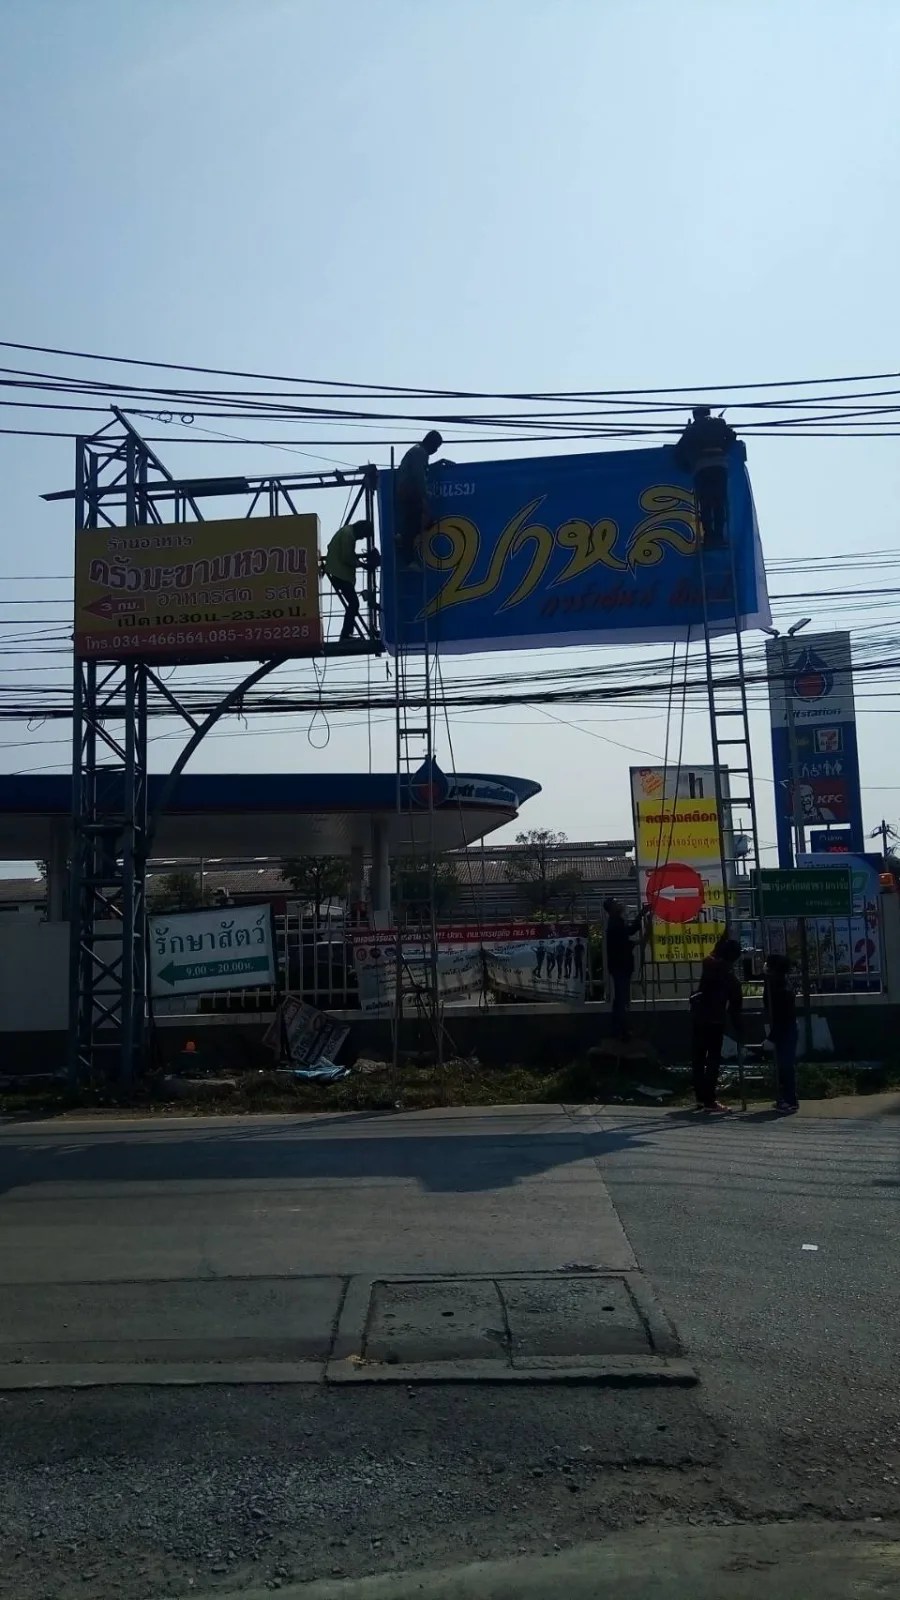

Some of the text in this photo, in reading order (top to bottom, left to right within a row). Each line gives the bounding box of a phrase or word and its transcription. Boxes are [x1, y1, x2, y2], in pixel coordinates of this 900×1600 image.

[107, 536, 194, 552] ร้านอาหาร
[89, 547, 308, 594] ครัวมะขามหวาน
[157, 579, 307, 607] อาหารสด รสดี
[100, 601, 141, 612] 3 กม.
[817, 794, 844, 805] KFC
[154, 914, 266, 956] รักษาสัตว์
[185, 965, 207, 977] 9.00
